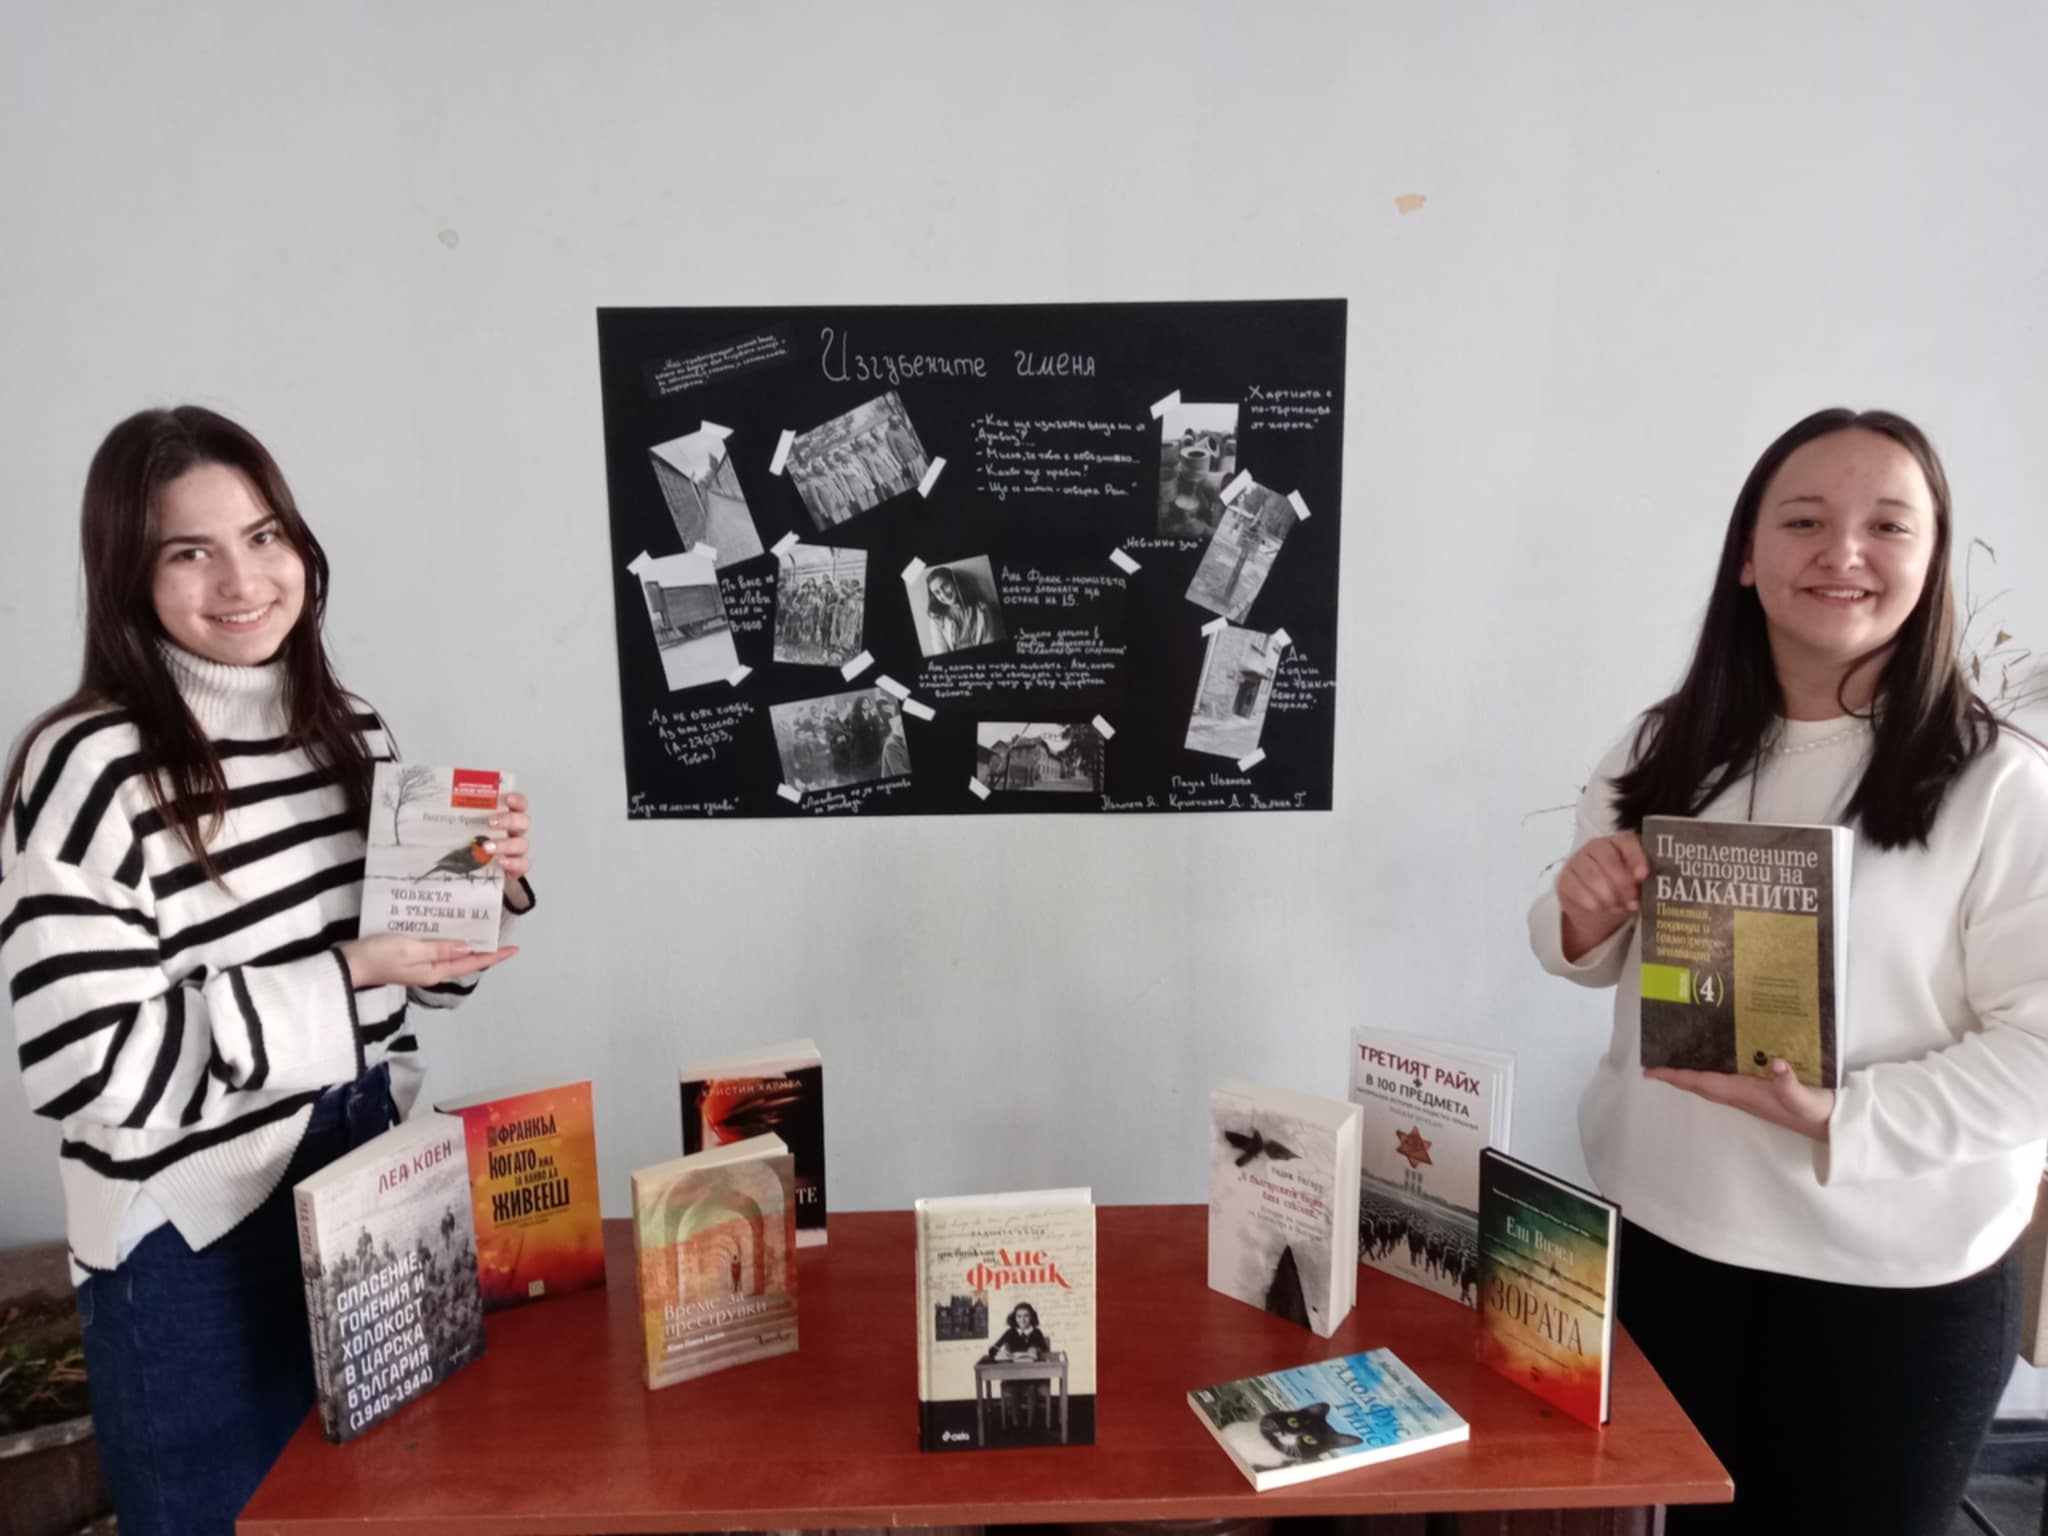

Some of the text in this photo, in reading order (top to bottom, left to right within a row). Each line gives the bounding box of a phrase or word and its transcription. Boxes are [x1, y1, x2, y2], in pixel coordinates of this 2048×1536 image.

[820, 327, 988, 386] Изгубените
[1657, 834, 1818, 869] Преплетените
[1680, 860, 1803, 885] истории на
[390, 906, 490, 920] В ТЪРСЕНЕ НА
[391, 889, 452, 902] ЧОВЕКЪТ
[1657, 875, 1819, 912] БАЛКАНИТЕ
[387, 921, 440, 933] СМИСЪЛ
[1358, 1044, 1480, 1097] ТРЕТИЯТ РАЙХ
[1365, 1074, 1373, 1086] В
[1377, 1077, 1397, 1094] 100
[1399, 1083, 1470, 1118] ПРЕДМЕТА
[498, 1114, 557, 1144] ФРАНКЪЛ
[378, 1141, 452, 1194] ЛЕА КОЕН
[488, 1147, 537, 1180] КОГАТО
[492, 1177, 570, 1222] ЖИВЕЕШ
[967, 1263, 1072, 1292] Франк
[999, 1248, 1048, 1267] Ане
[337, 1252, 423, 1312] СПАСЕНИЕ,
[338, 1280, 425, 1337] ГОНЕНИЯ И
[341, 1297, 424, 1362] ХОЛОКОСТ
[1490, 1278, 1583, 1356] ЗОРАТА
[344, 1363, 356, 1384] В
[361, 1323, 425, 1376] ЦАРСКА
[348, 1344, 430, 1409] БЪЛГАРИЯ
[349, 1366, 434, 1431] (1940-1944)
